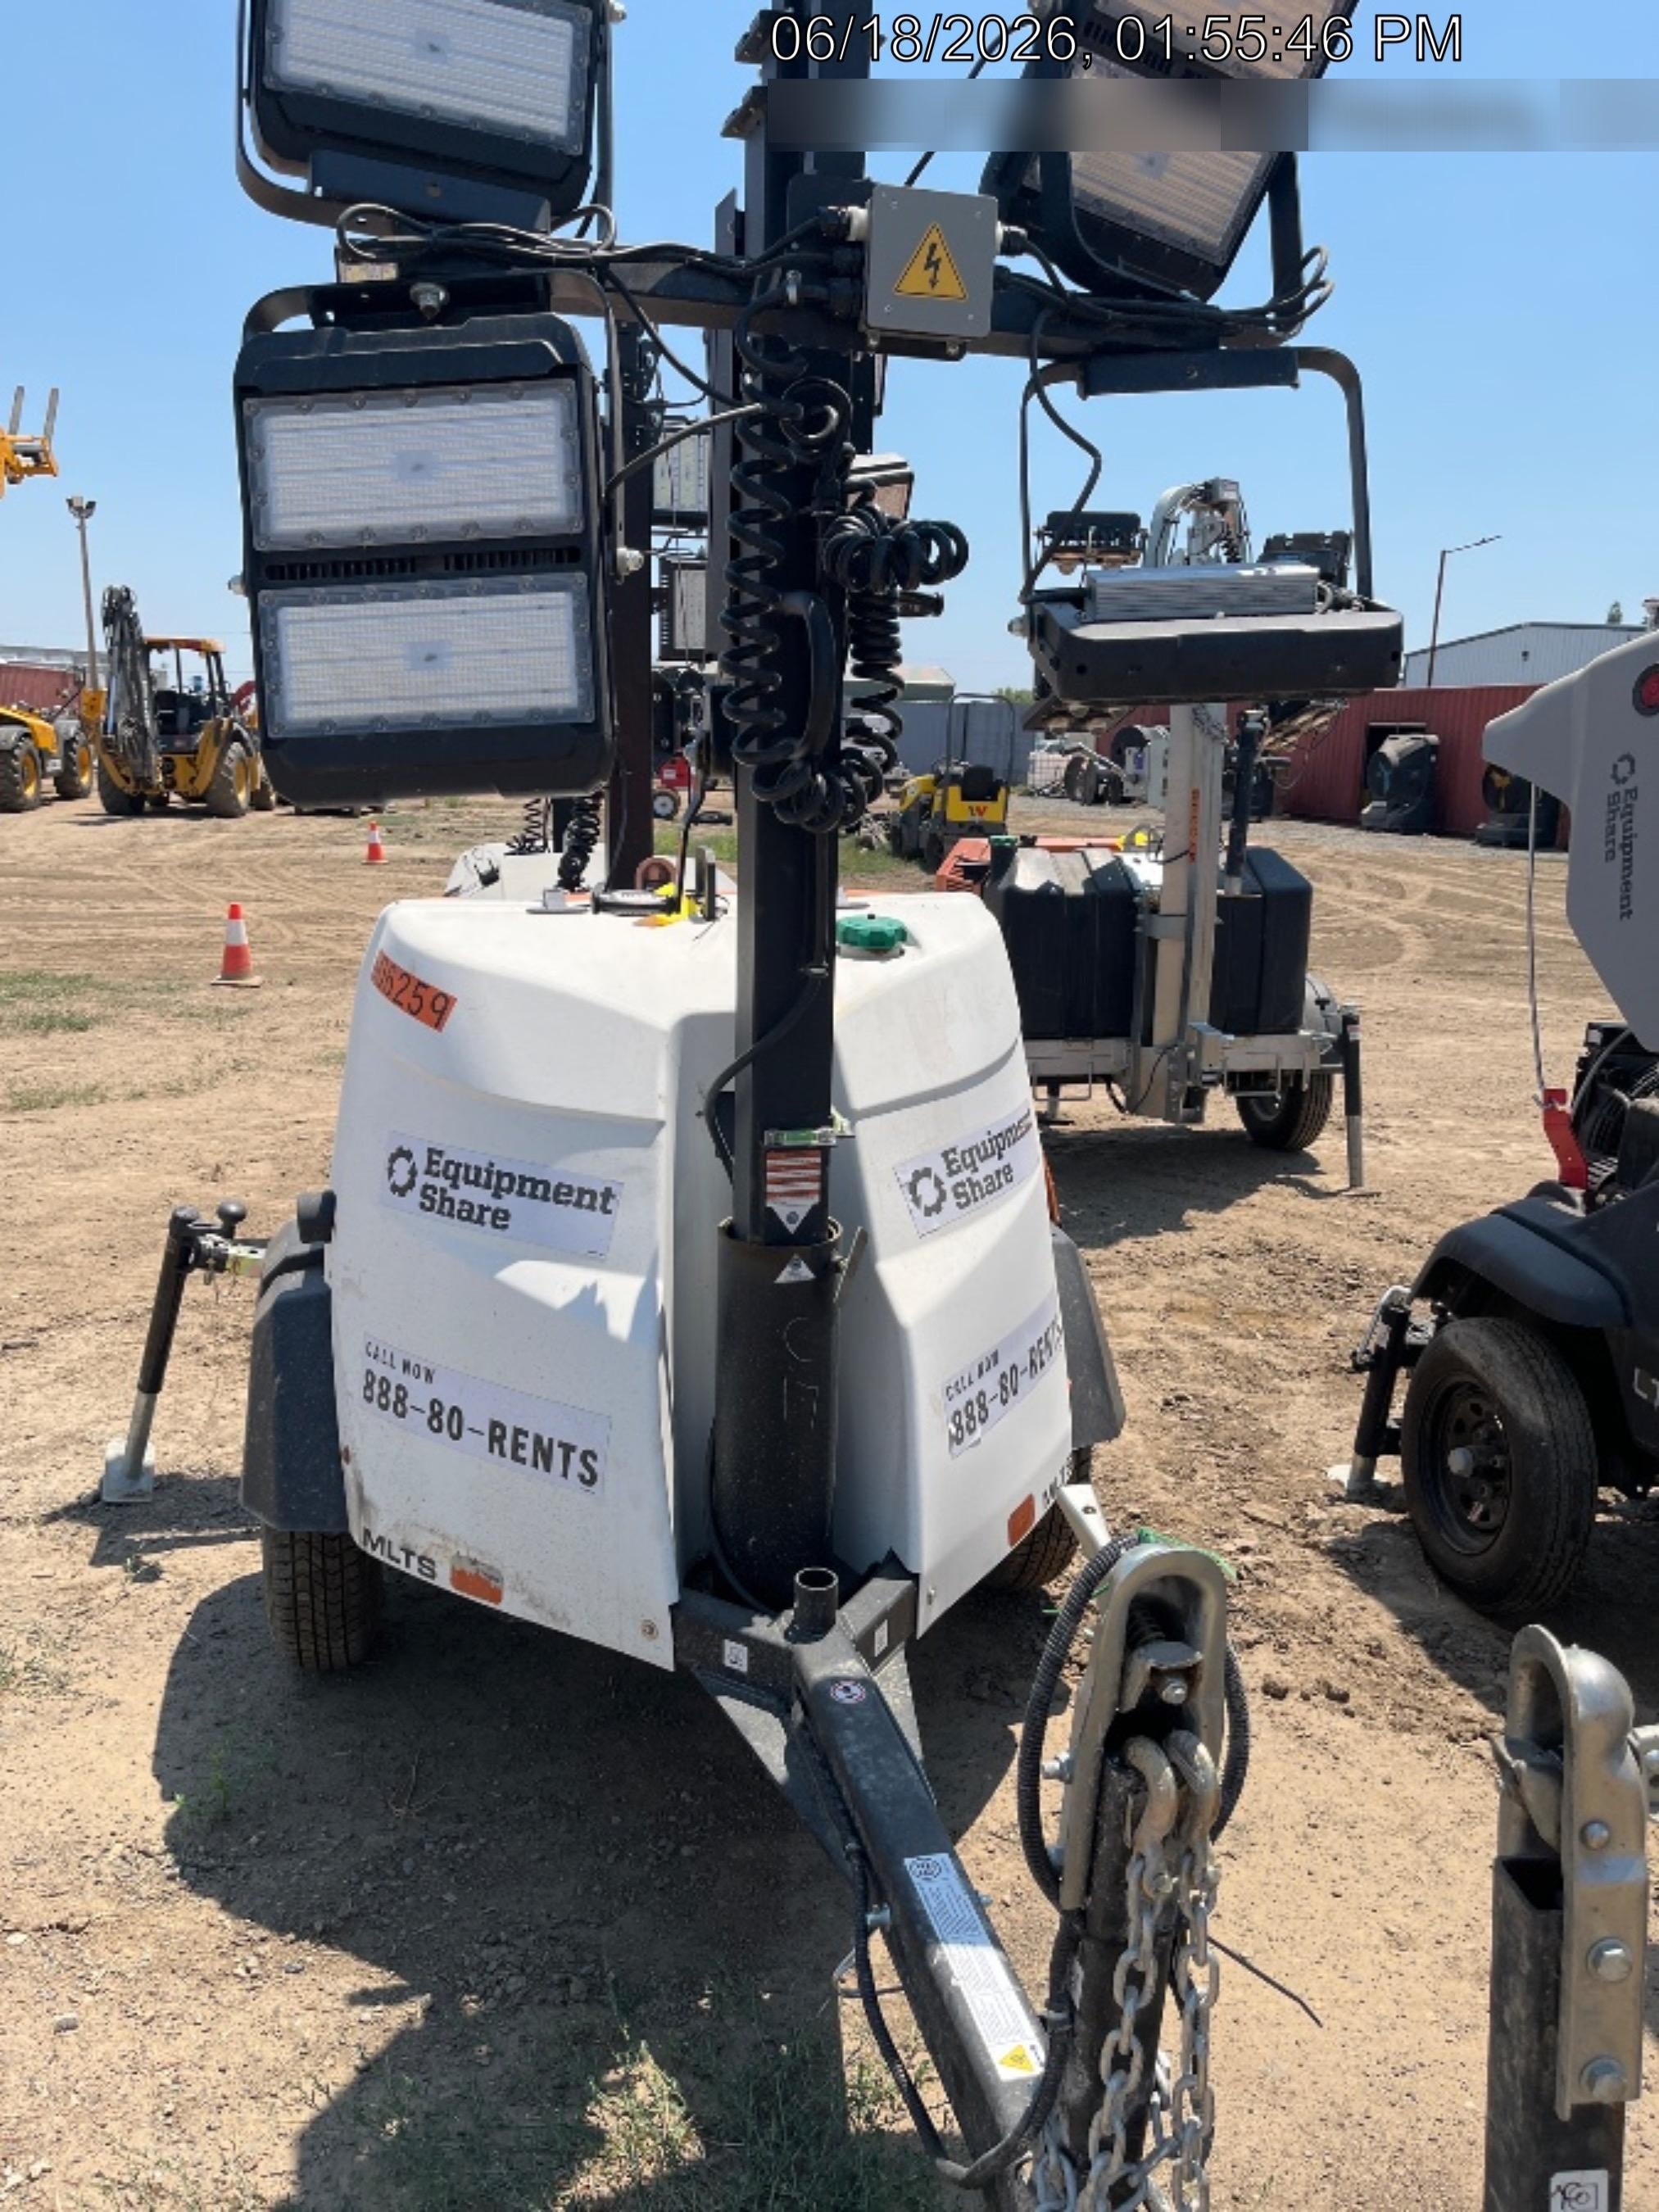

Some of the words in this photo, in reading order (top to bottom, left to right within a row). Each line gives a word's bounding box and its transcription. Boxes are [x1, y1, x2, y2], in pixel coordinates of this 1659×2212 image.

[419, 1181, 511, 1230] Share
[424, 1147, 615, 1214] Equipment
[952, 1163, 1014, 1210] Share
[365, 1341, 397, 1369] CALL
[401, 1358, 437, 1385] NOW
[363, 1368, 599, 1488] 888-80-RENTS
[363, 1527, 436, 1580] MLTS
